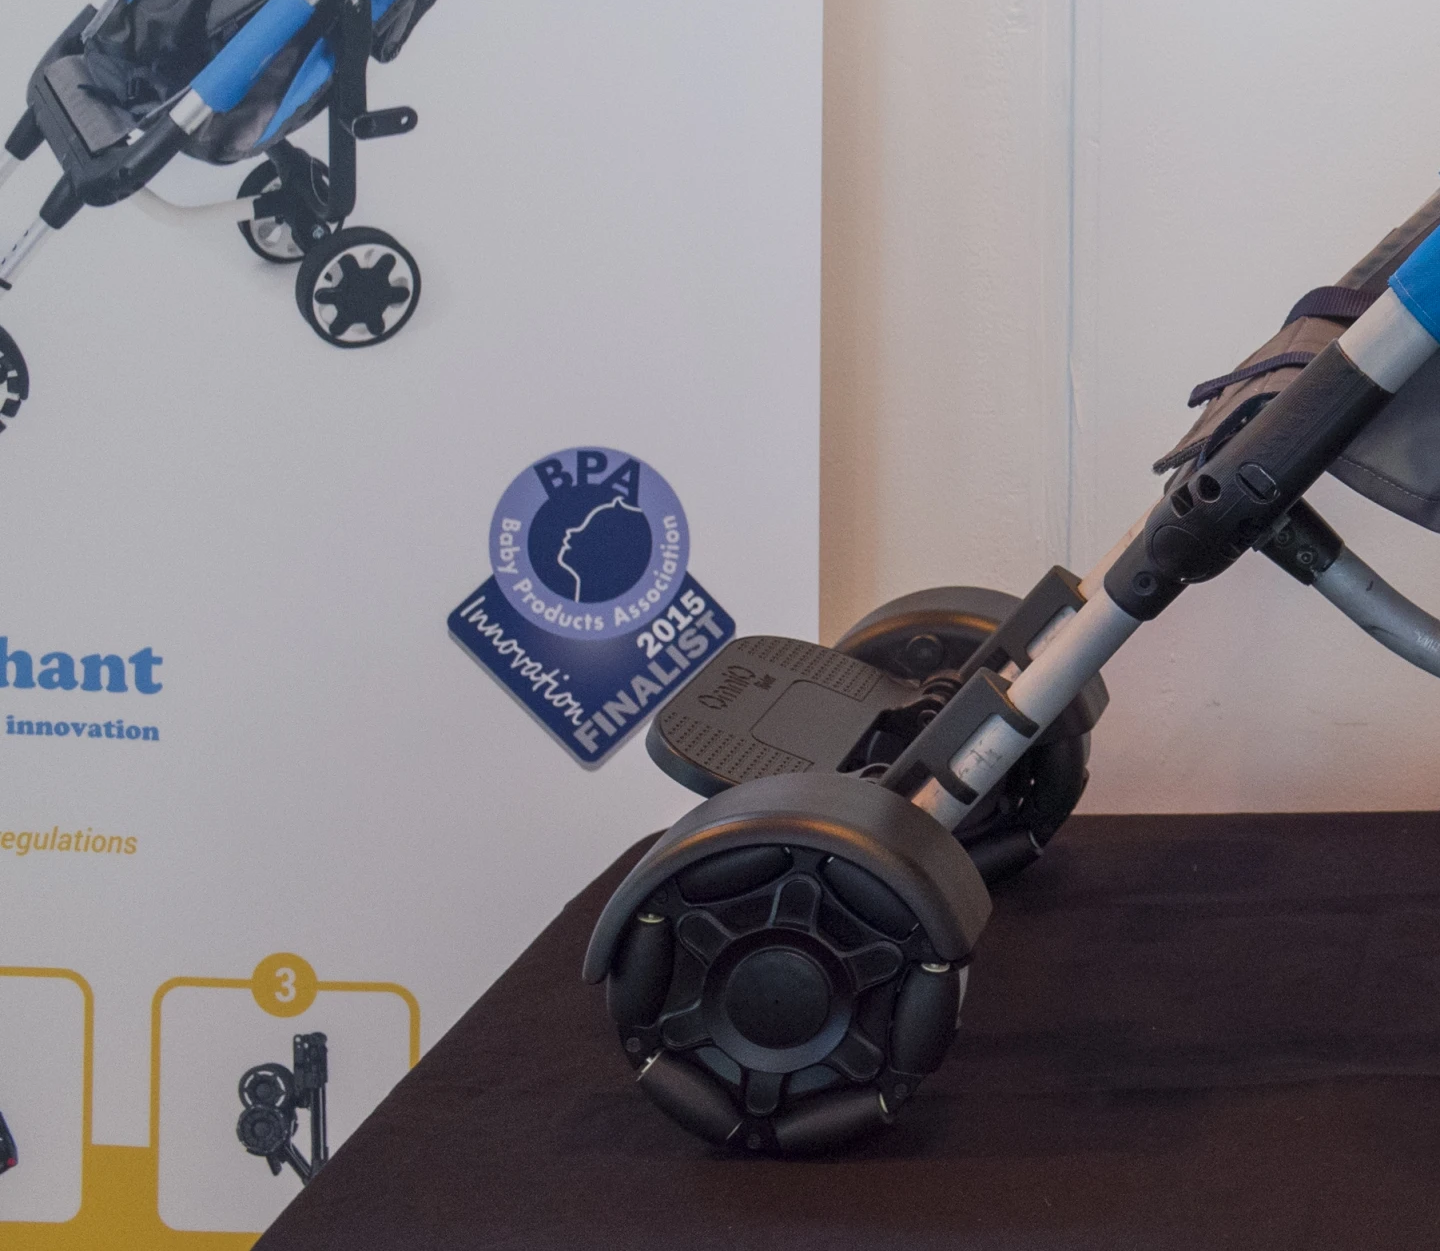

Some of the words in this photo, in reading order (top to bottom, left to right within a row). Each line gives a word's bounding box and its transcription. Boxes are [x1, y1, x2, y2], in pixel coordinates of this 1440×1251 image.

[533, 450, 641, 505] BPA
[497, 517, 521, 575] Baby
[512, 578, 604, 631] Products
[613, 514, 680, 627] Association
[636, 589, 706, 658] 2015
[459, 595, 584, 726] Innovation
[572, 609, 725, 754] FINALIST
[7, 715, 160, 741] innovation
[0, 825, 138, 857] egulations
[274, 967, 297, 1003] 3
